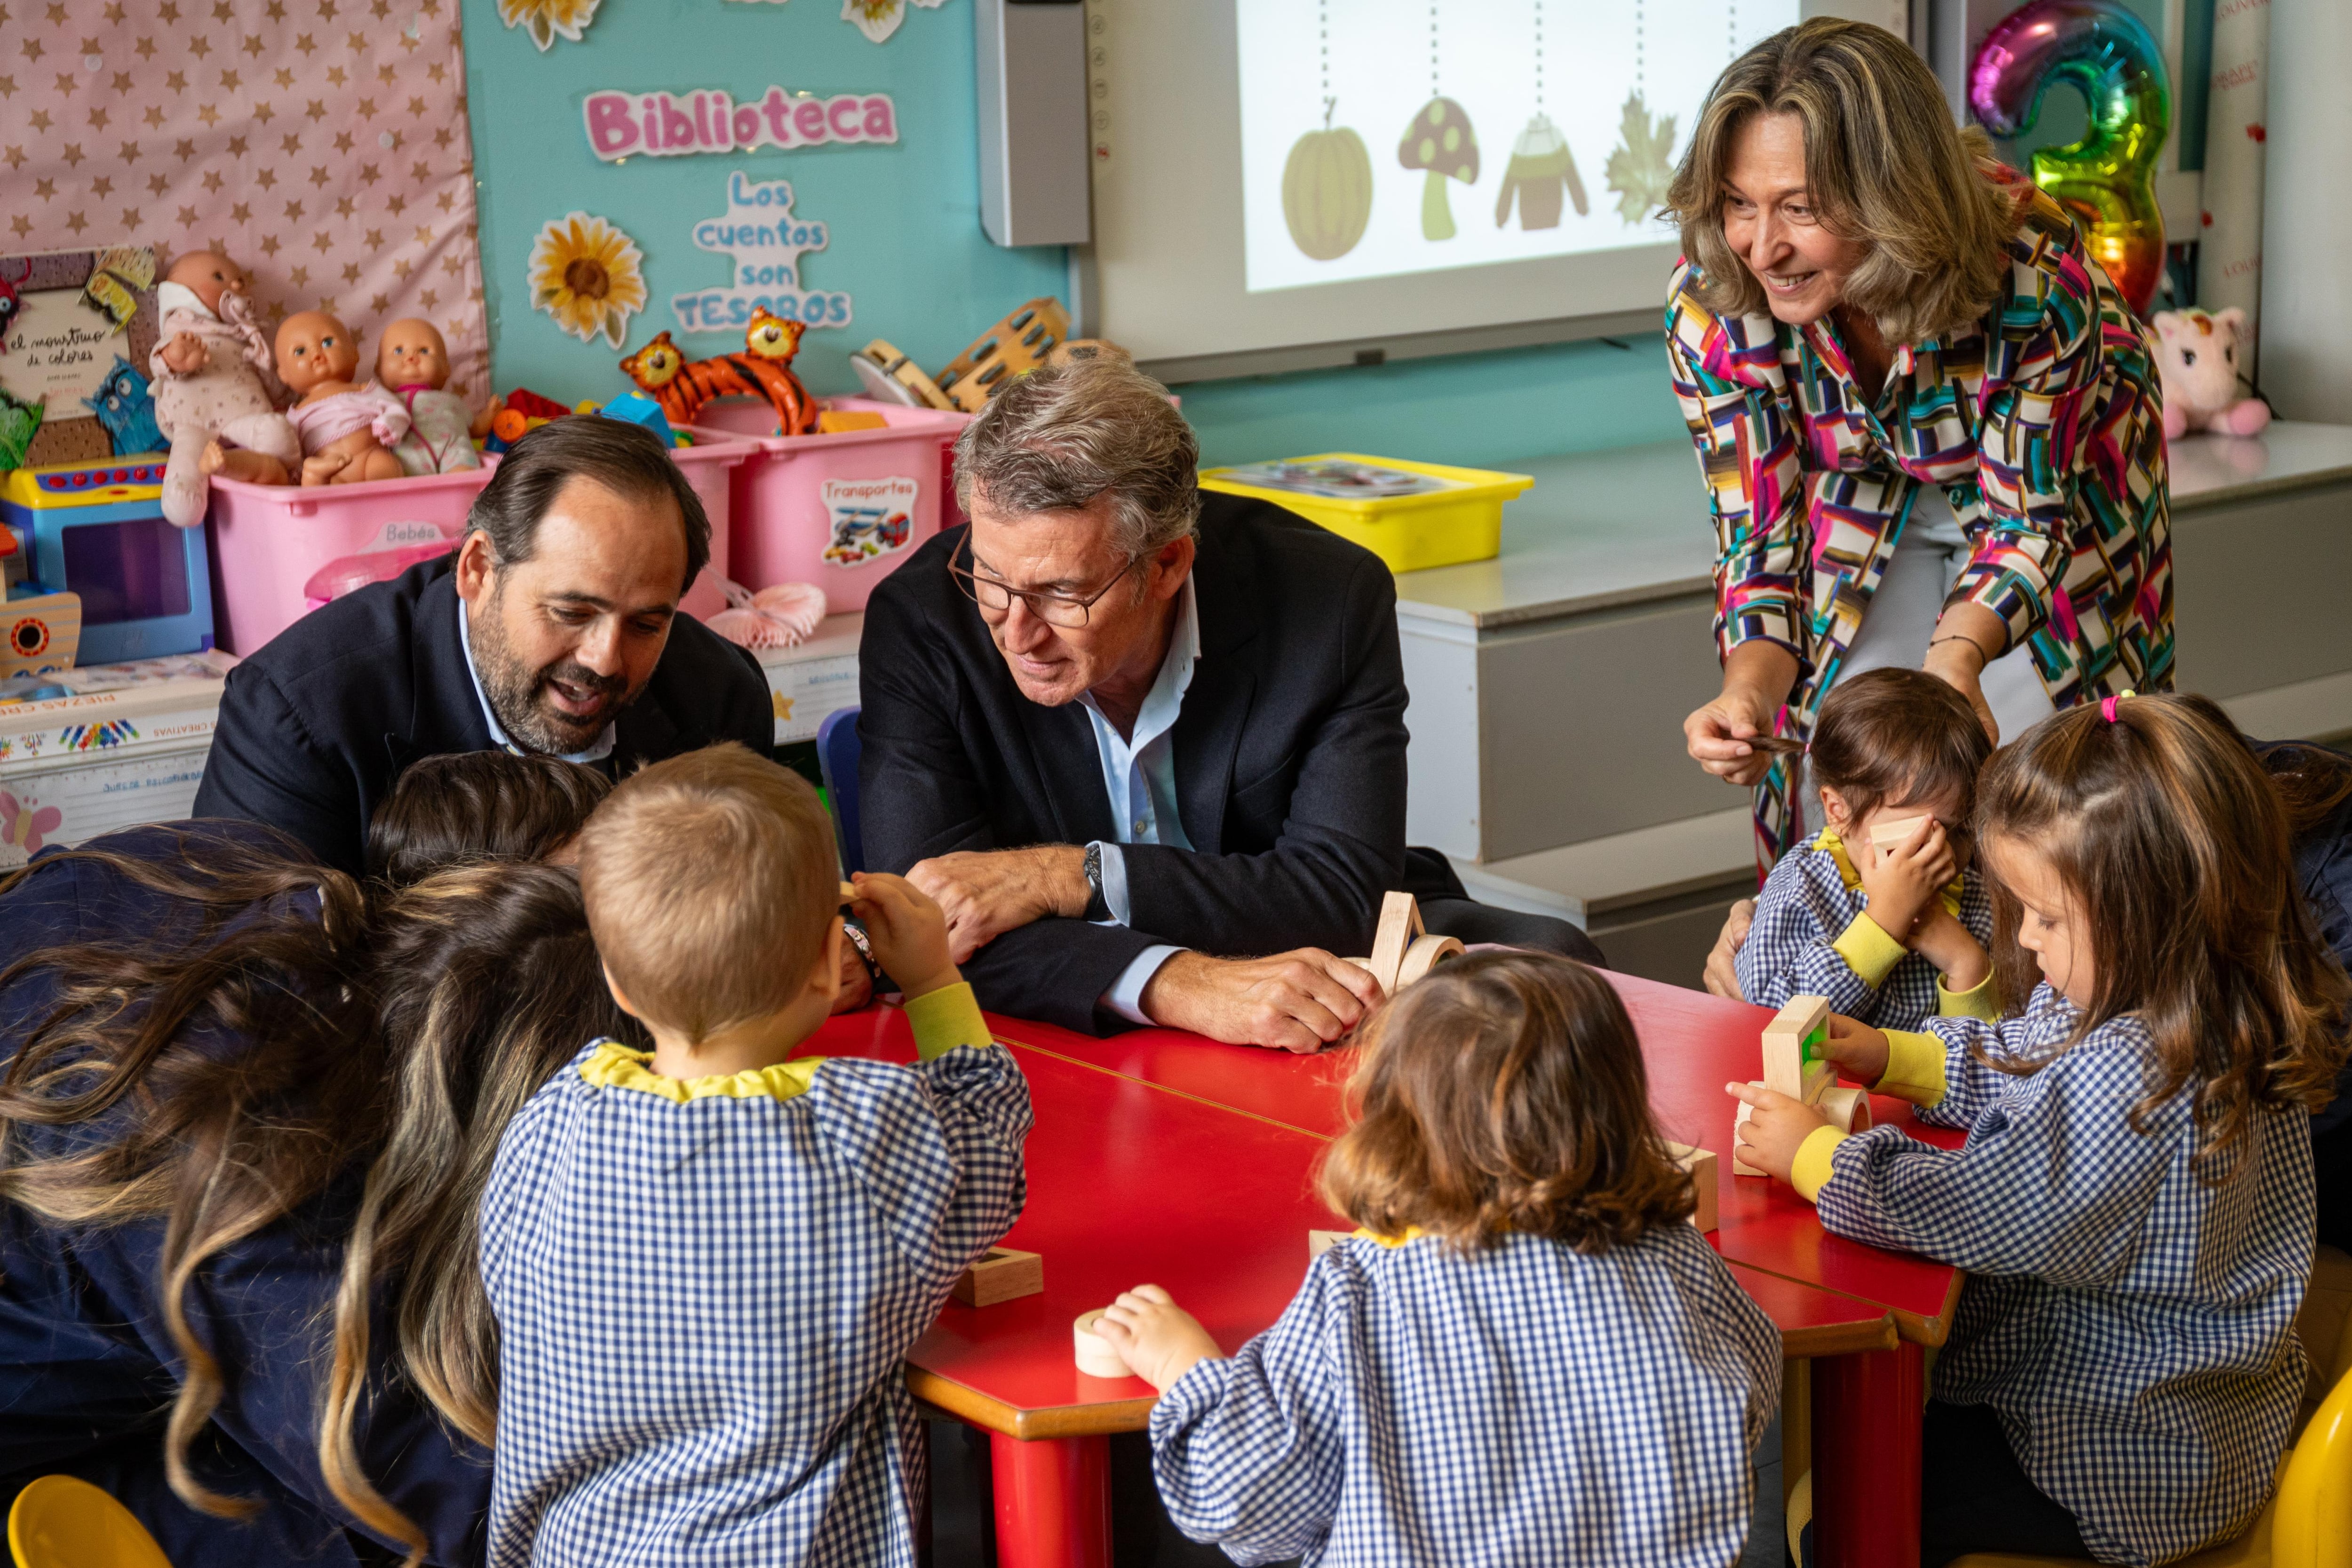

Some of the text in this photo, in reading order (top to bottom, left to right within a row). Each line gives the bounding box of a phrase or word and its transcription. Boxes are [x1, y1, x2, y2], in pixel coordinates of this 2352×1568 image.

[588, 90, 893, 154] Biblioteca
[732, 174, 789, 206] Los
[697, 218, 824, 247] cuentos
[741, 264, 794, 285] son
[11, 328, 105, 350] el monstruo
[27, 349, 93, 367] de colores
[824, 481, 913, 499] Transportes
[387, 524, 435, 541] Bebés
[41, 693, 116, 710] PIEZAS
[153, 722, 207, 737] CREATIVAS
